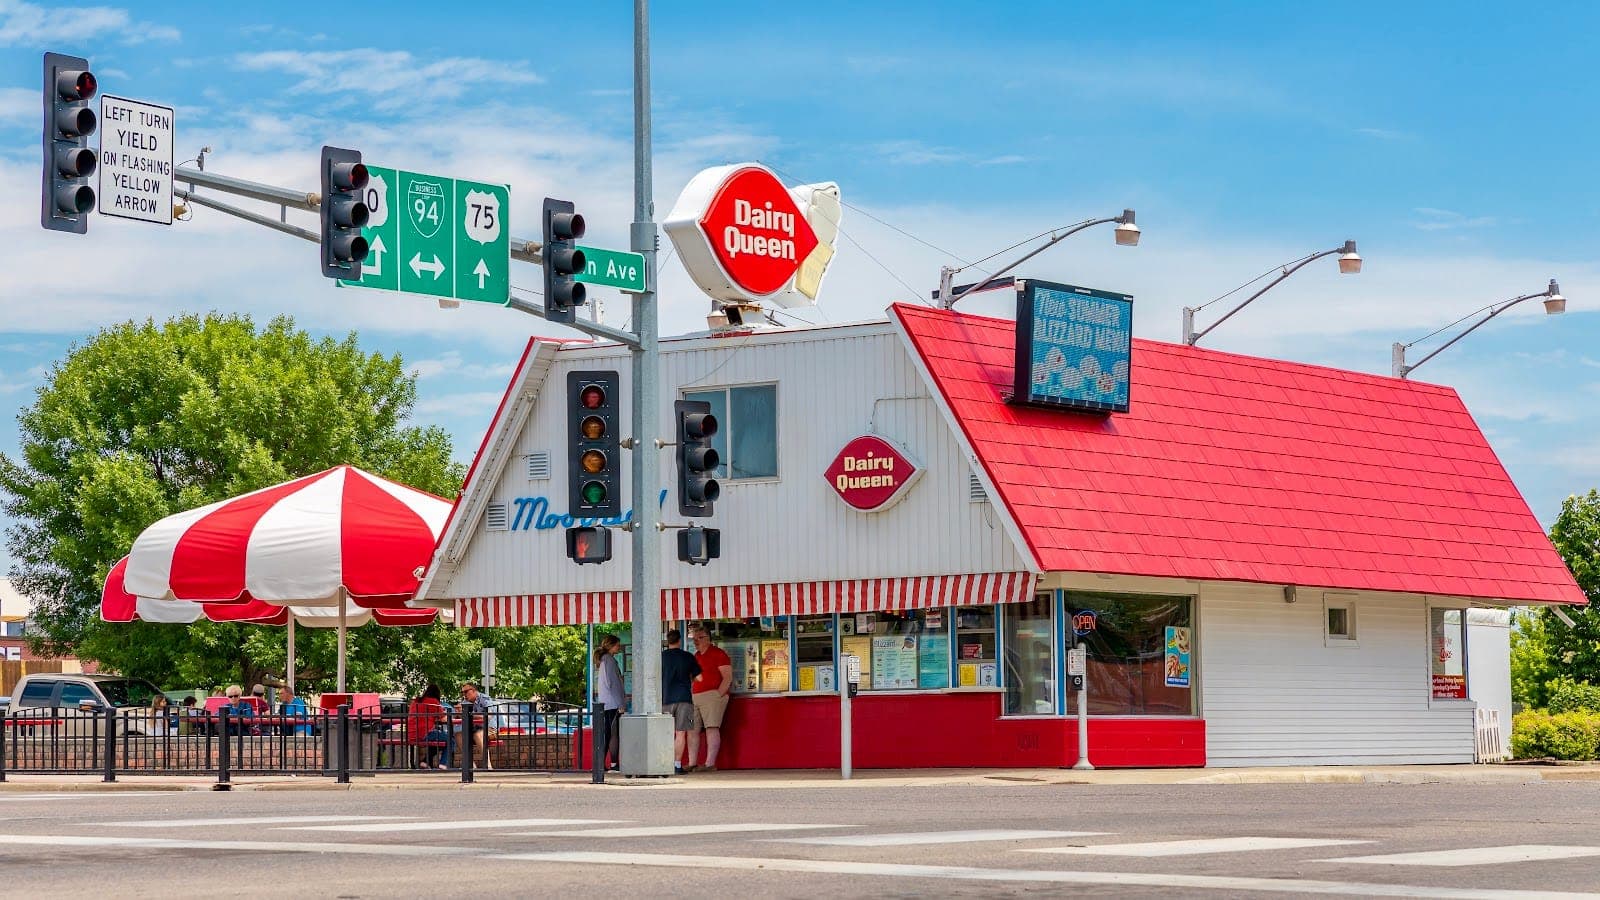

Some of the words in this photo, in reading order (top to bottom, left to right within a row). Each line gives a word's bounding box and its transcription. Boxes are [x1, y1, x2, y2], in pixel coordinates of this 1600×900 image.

[105, 104, 133, 123] LEFT
[139, 112, 169, 131] TURN
[117, 129, 158, 152] YIELD
[103, 151, 117, 166] ON
[121, 153, 171, 176] FLASHING
[113, 172, 160, 194] YELLOW
[115, 194, 157, 214] ARROW
[366, 187, 379, 213] 0
[414, 198, 439, 226] 94
[471, 203, 495, 230] 75
[734, 199, 795, 234] Dairy
[724, 226, 796, 260] Queen
[583, 260, 597, 275] n
[606, 258, 637, 281] Ave
[844, 451, 894, 472] Dairy
[836, 473, 894, 493] Queen
[1072, 614, 1096, 630] OPEN
